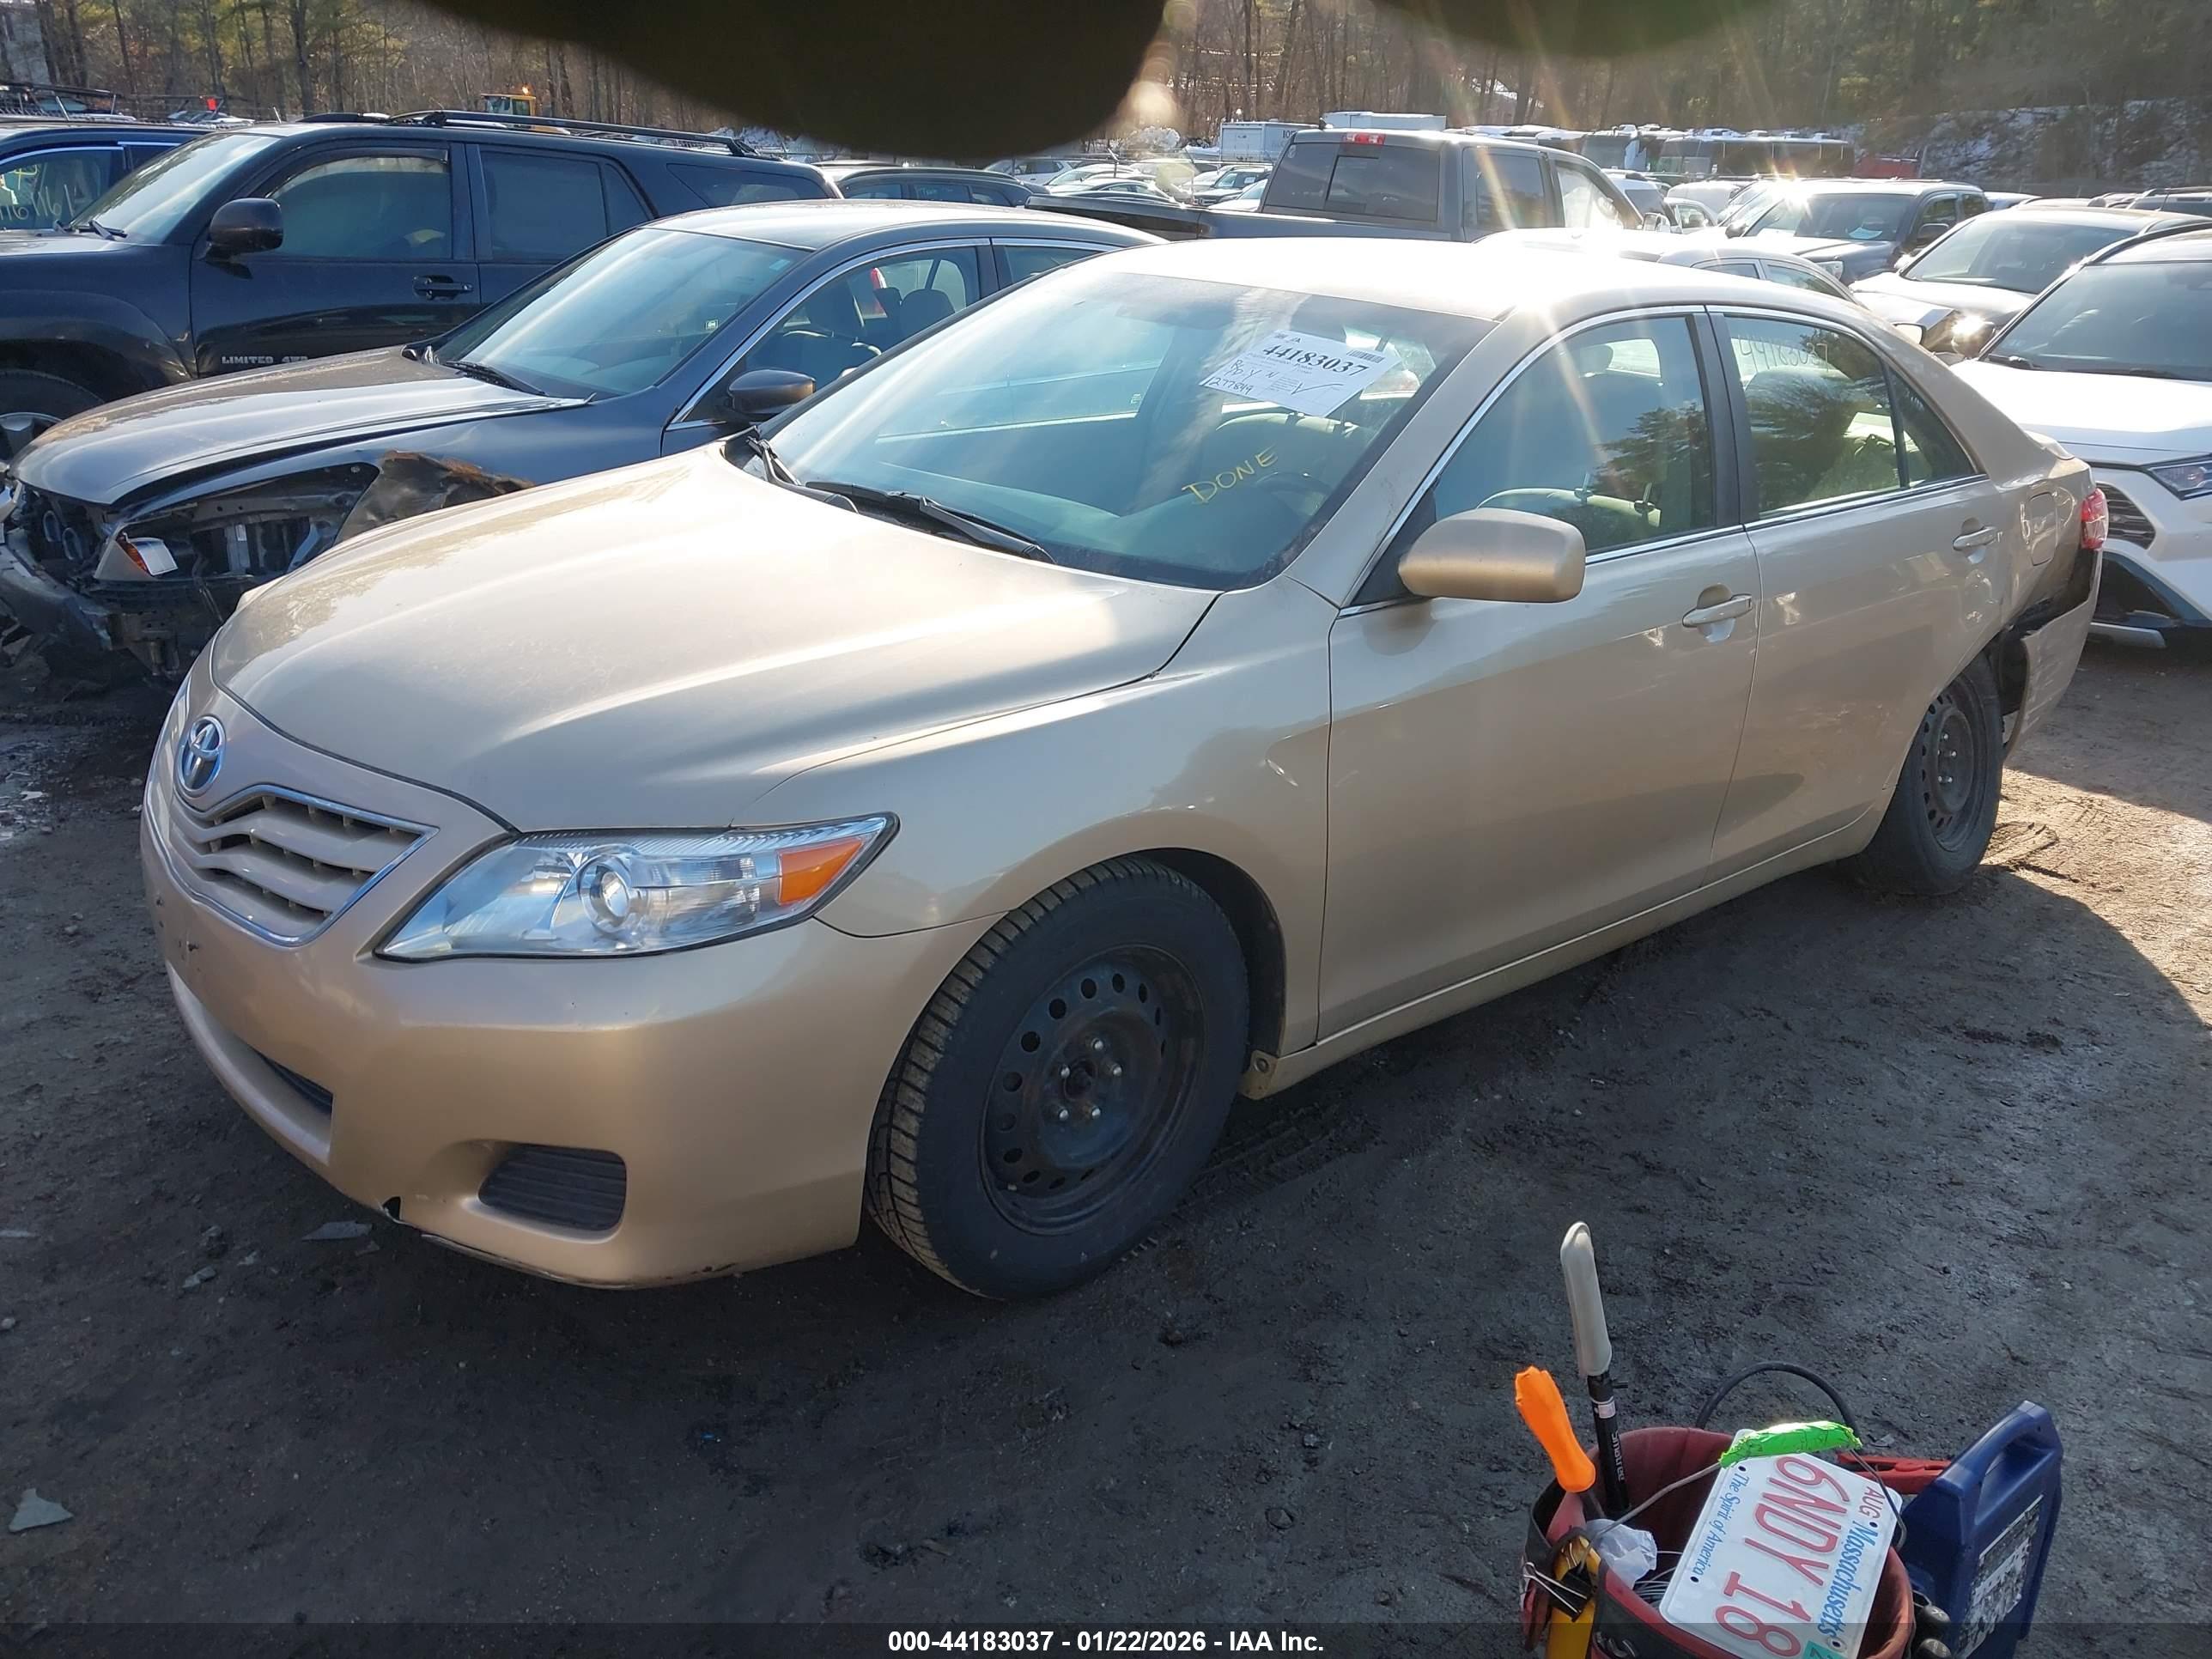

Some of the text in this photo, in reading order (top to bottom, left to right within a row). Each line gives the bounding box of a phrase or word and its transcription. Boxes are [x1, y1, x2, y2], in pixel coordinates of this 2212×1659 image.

[222, 356, 274, 364] LIMITED
[1262, 344, 1370, 376] 44183037
[1737, 334, 1829, 373] 44183037
[1182, 443, 1279, 505] DONE
[1692, 1473, 1749, 1577] The Spirit of America
[1859, 1486, 1886, 1524] AUG
[1714, 1455, 1850, 1658] 6NDY 18
[1817, 1520, 1879, 1641] Massachusetts
